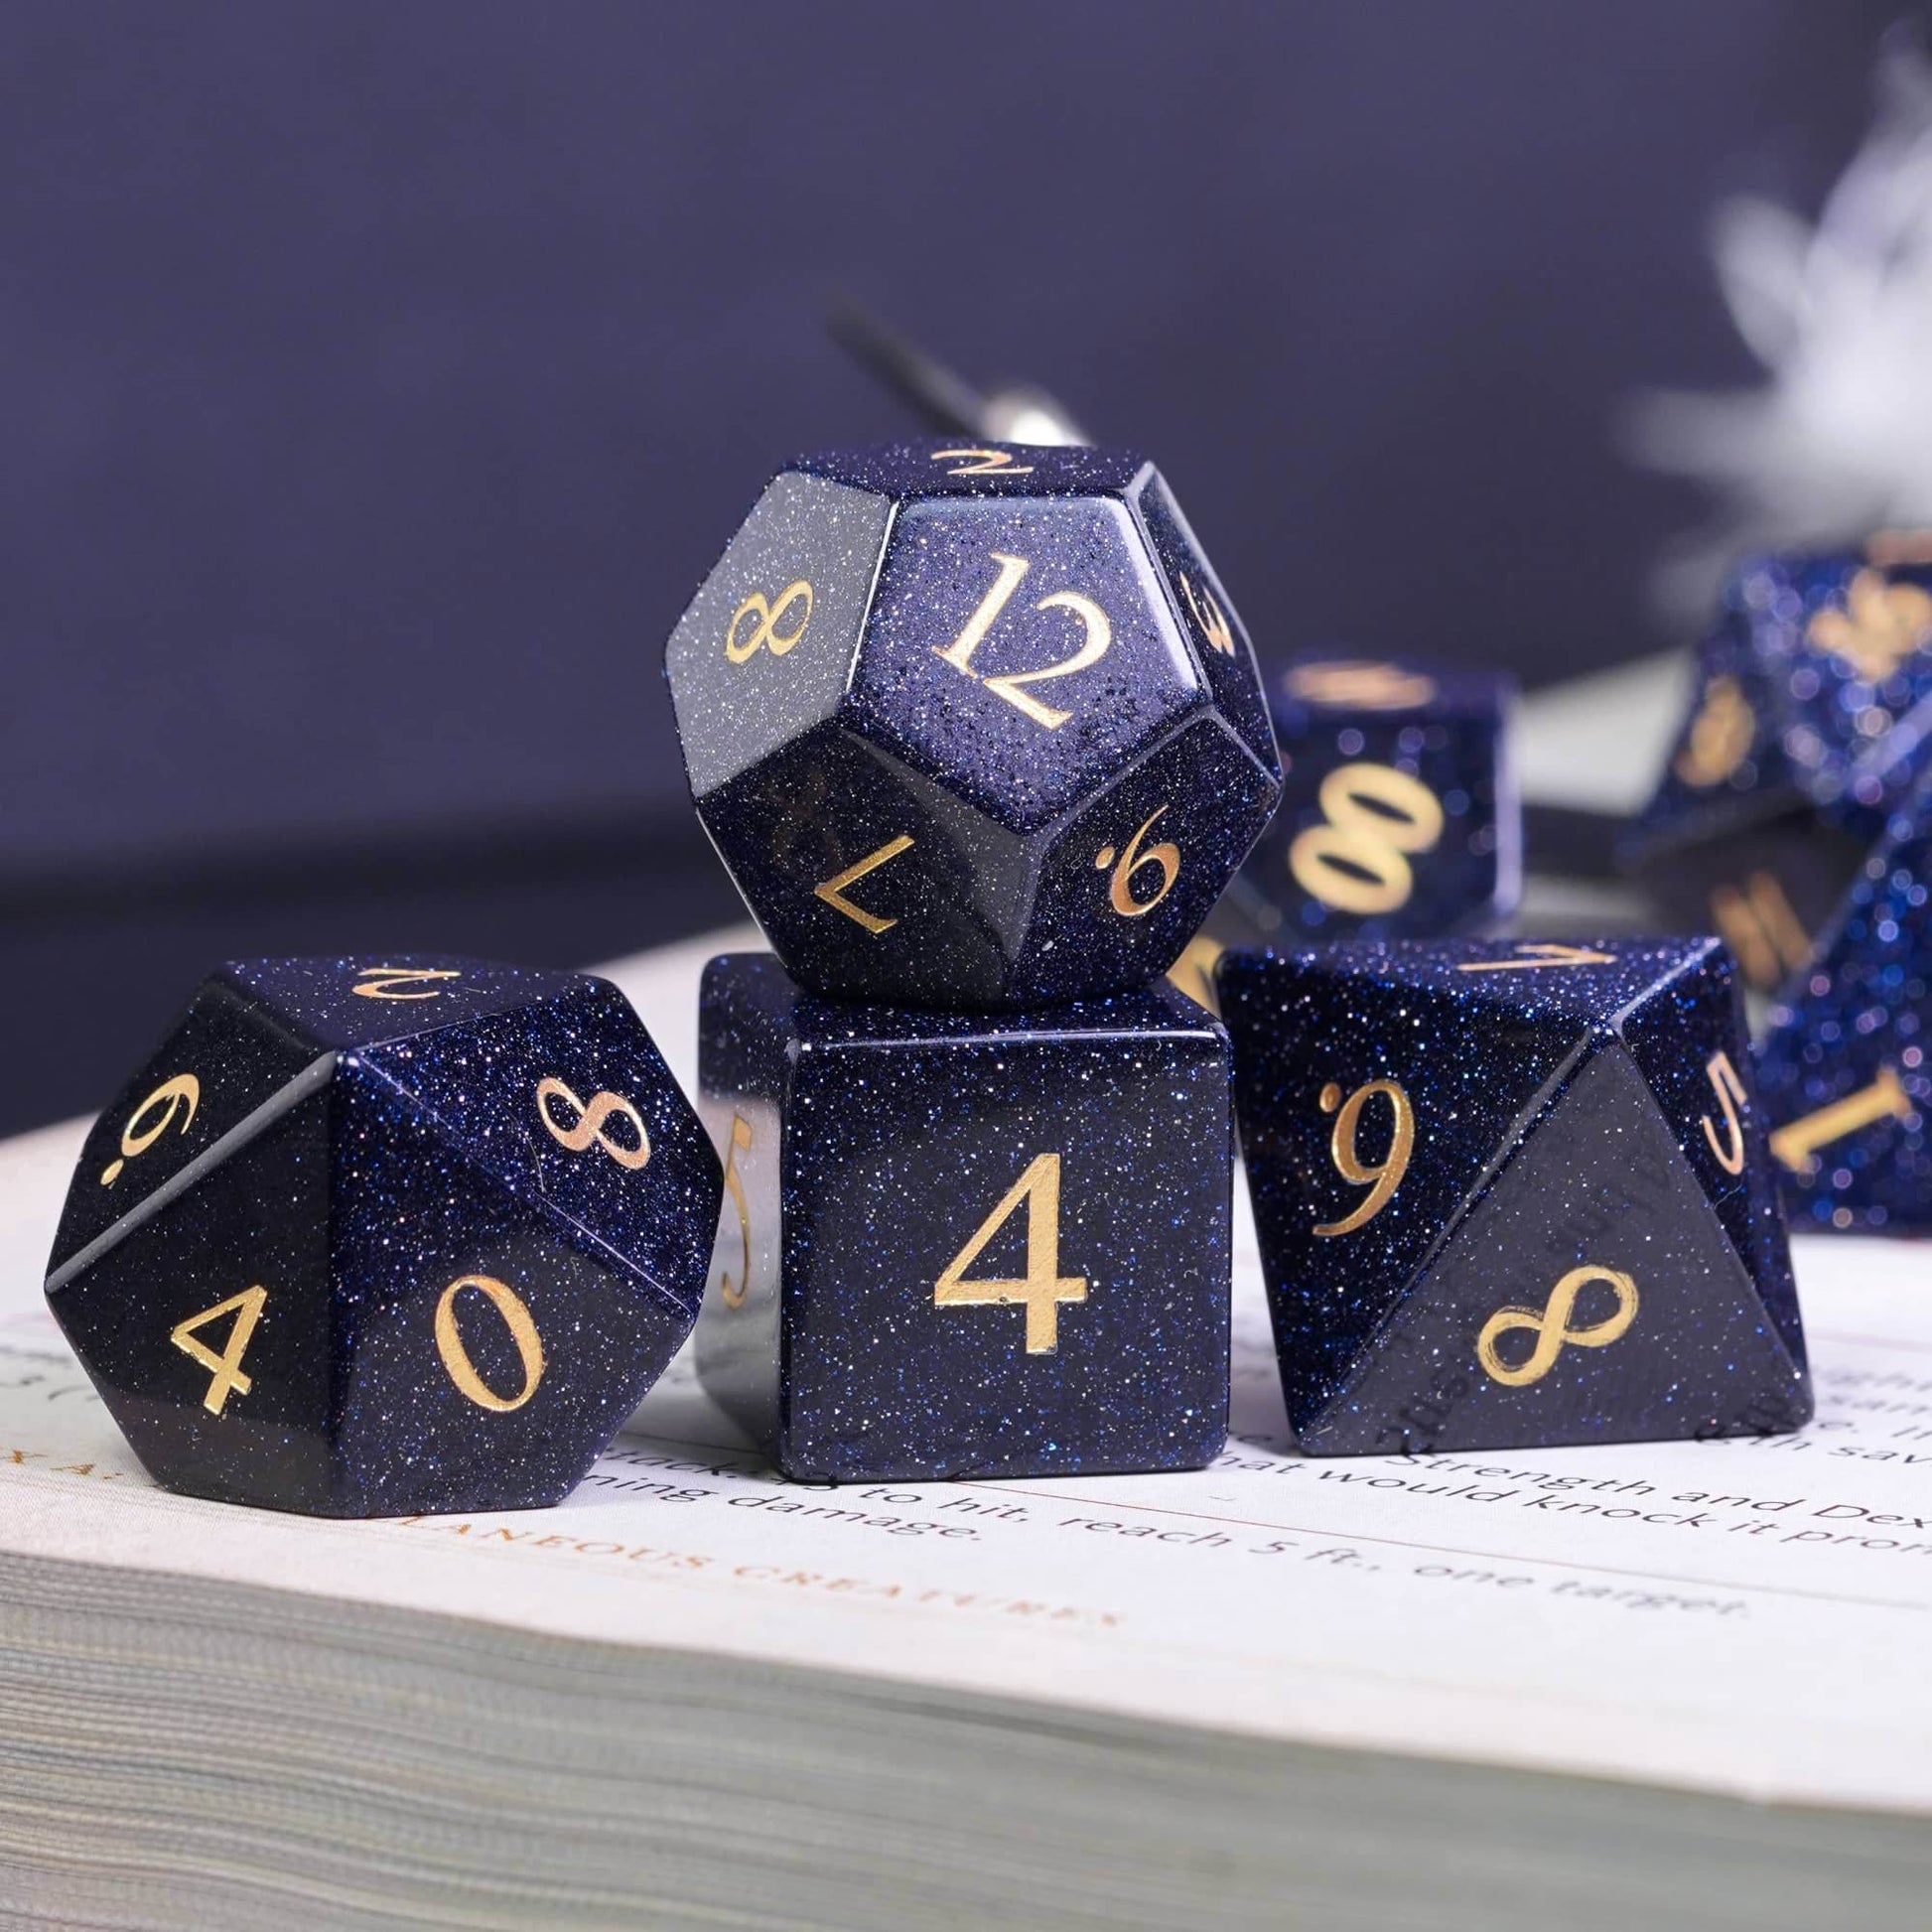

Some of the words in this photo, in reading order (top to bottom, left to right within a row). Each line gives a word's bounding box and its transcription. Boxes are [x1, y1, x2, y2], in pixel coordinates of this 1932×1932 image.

[930, 449, 1034, 476] 2
[724, 579, 814, 664] 8
[932, 552, 1112, 731] 12
[1179, 571, 1235, 657] 3
[813, 834, 915, 935] 7
[351, 968, 462, 1000] 2
[536, 1077, 650, 1170] 8
[934, 1153, 1088, 1355] 4
[170, 1285, 268, 1416] 4
[435, 1275, 547, 1413] 0
[1477, 1264, 1639, 1387] 8
[728, 1495, 982, 1541] damage.
[1318, 1468, 1521, 1502] would
[1522, 1493, 1718, 1528] knock
[1727, 1519, 1780, 1535] it
[1384, 1452, 1657, 1496] Strength
[1671, 1491, 1807, 1512] and
[1812, 1504, 1932, 1529] Dex
[371, 1515, 713, 1567] LANEOUS
[859, 1487, 922, 1504] to
[936, 1497, 1029, 1523] hit,
[1057, 1517, 1232, 1549] reach
[1248, 1541, 1299, 1555] 5
[1414, 1564, 1535, 1588] one
